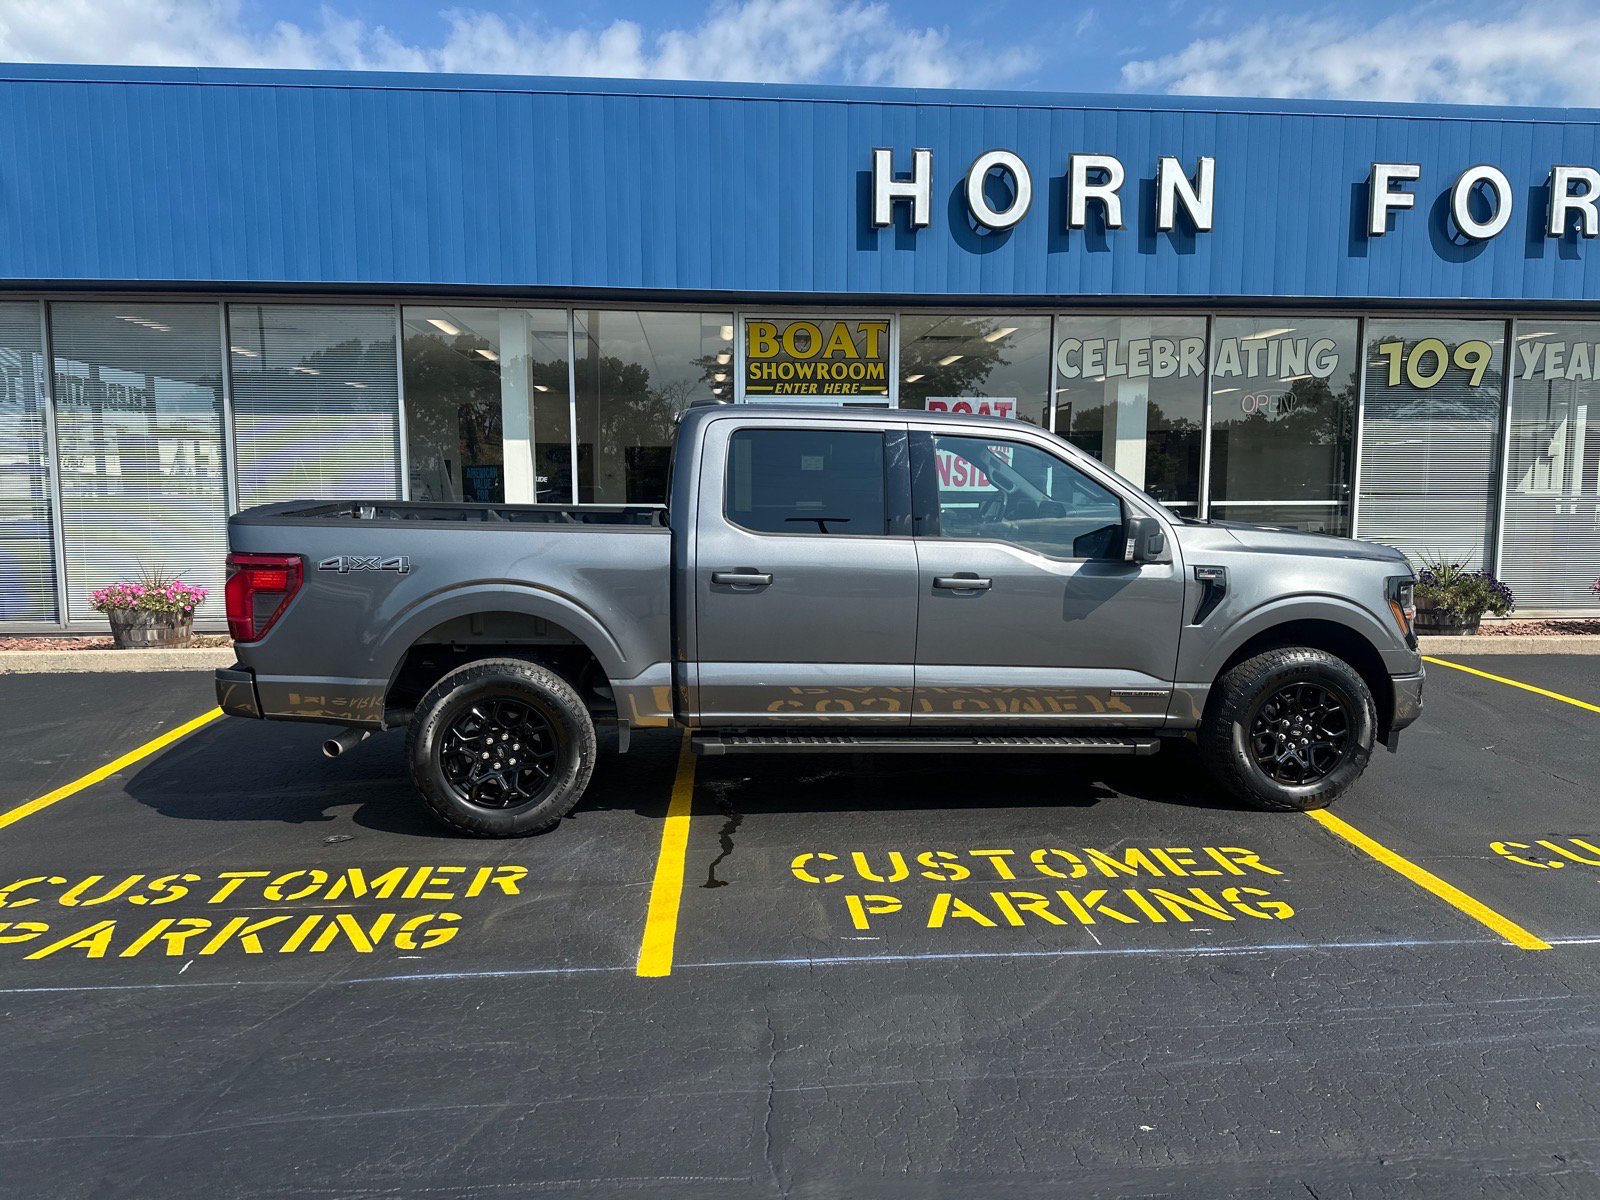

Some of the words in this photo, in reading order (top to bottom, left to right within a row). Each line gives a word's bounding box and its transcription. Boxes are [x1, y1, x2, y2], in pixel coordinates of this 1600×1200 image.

[871, 147, 1217, 232] HORN
[1367, 162, 1600, 241] FOR
[747, 321, 889, 359] BOAT
[749, 362, 886, 381] SHOWROOM
[1057, 337, 1340, 379] CELEBRATING
[1379, 337, 1493, 390] 109
[774, 383, 818, 395] ENTER
[823, 382, 860, 394] HERE
[1241, 391, 1294, 413] OPEN
[790, 846, 1284, 884] CUSTOMER
[0, 864, 529, 908] CUSTOMER
[845, 887, 1296, 931] PARKING
